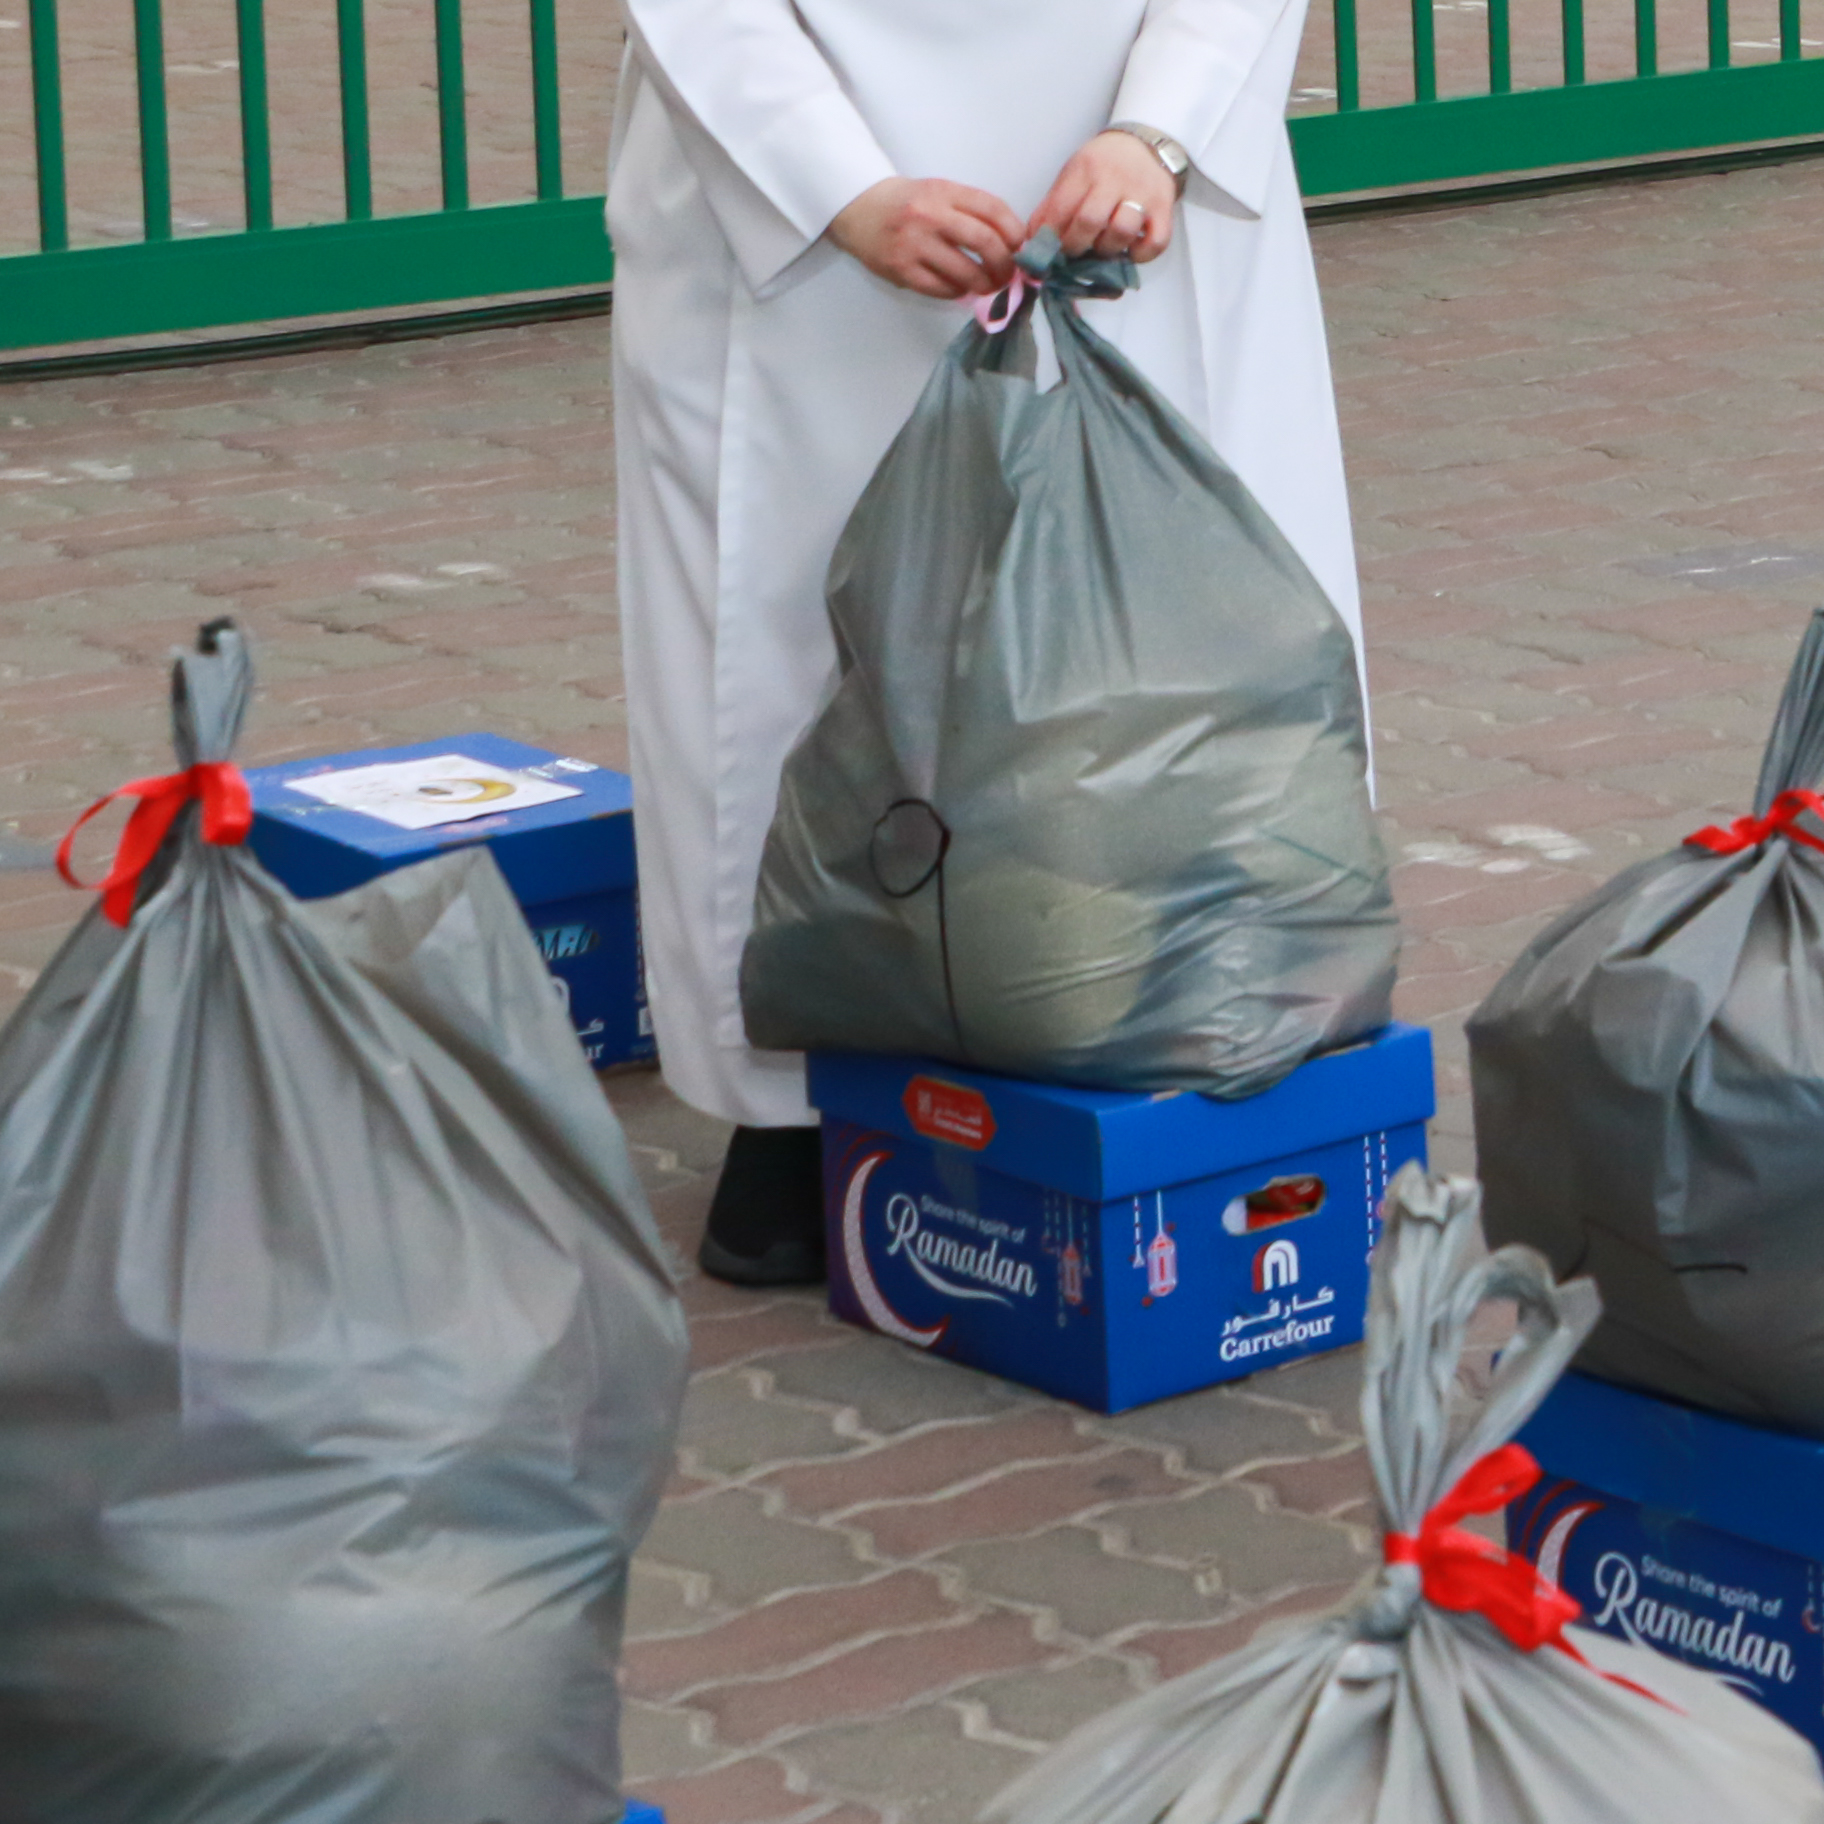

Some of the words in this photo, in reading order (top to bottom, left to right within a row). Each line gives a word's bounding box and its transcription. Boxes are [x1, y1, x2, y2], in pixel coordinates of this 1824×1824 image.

[886, 1193, 1038, 1306] Ramadan
[1220, 1315, 1335, 1363] Carrefour
[1594, 1551, 1796, 1690] Ramadan
[1641, 1553, 1686, 1589] Share
[1689, 1574, 1716, 1598] the
[1719, 1585, 1760, 1613] spirit
[1762, 1597, 1783, 1619] of
